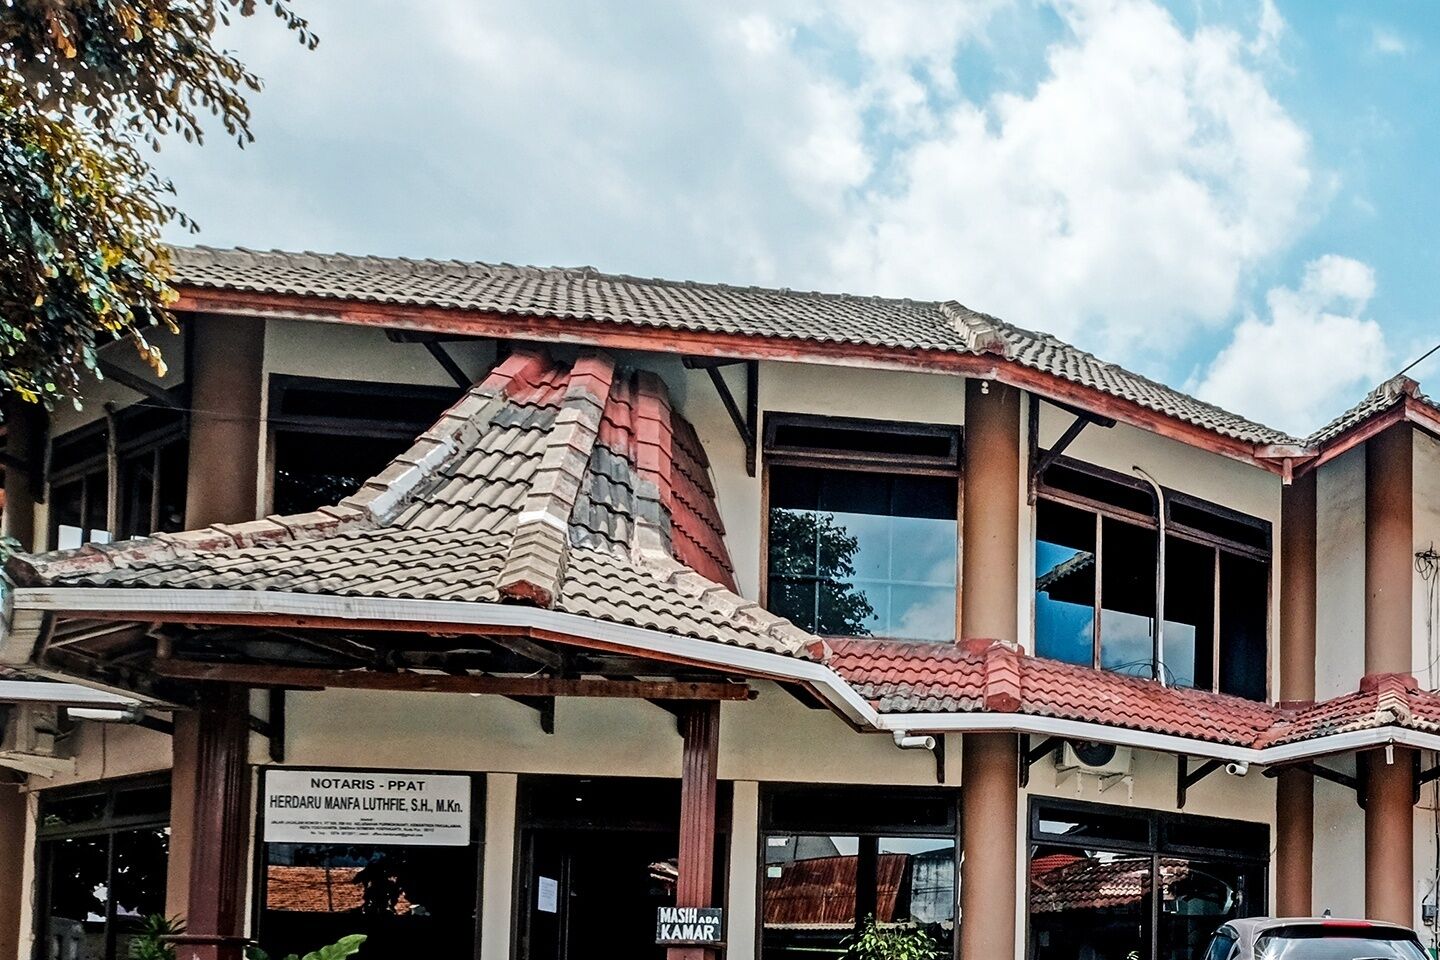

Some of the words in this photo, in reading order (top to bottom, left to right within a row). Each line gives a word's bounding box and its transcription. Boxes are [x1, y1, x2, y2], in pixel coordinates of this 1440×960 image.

[311, 778, 375, 790] NOTARIS
[388, 780, 425, 791] PPAT
[270, 795, 321, 809] HERDARU
[324, 796, 360, 810] MANFA
[363, 797, 408, 812] LUTHFIE,
[411, 798, 433, 812] S.H.,
[436, 799, 463, 812] M.Kn.
[660, 908, 697, 923] MASIH
[698, 916, 719, 924] ADA
[661, 924, 714, 940] KAMAR
